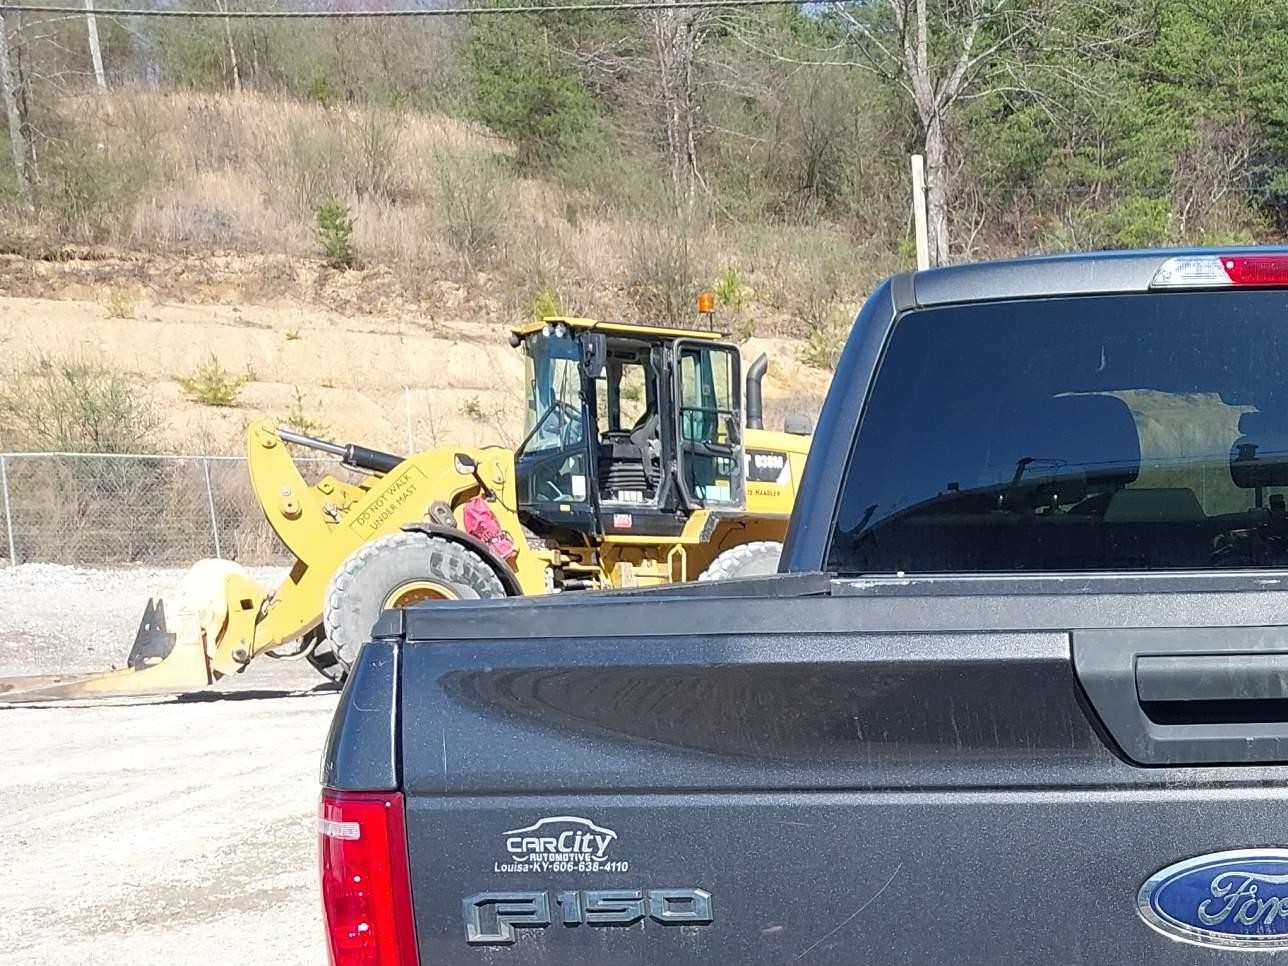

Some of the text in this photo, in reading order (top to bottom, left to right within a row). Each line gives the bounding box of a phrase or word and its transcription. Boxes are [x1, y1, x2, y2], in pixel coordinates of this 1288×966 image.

[357, 474, 411, 526] DO NOT WALK
[370, 485, 416, 530] UNDER MAST
[529, 853, 591, 862] AUTOMOTIVE
